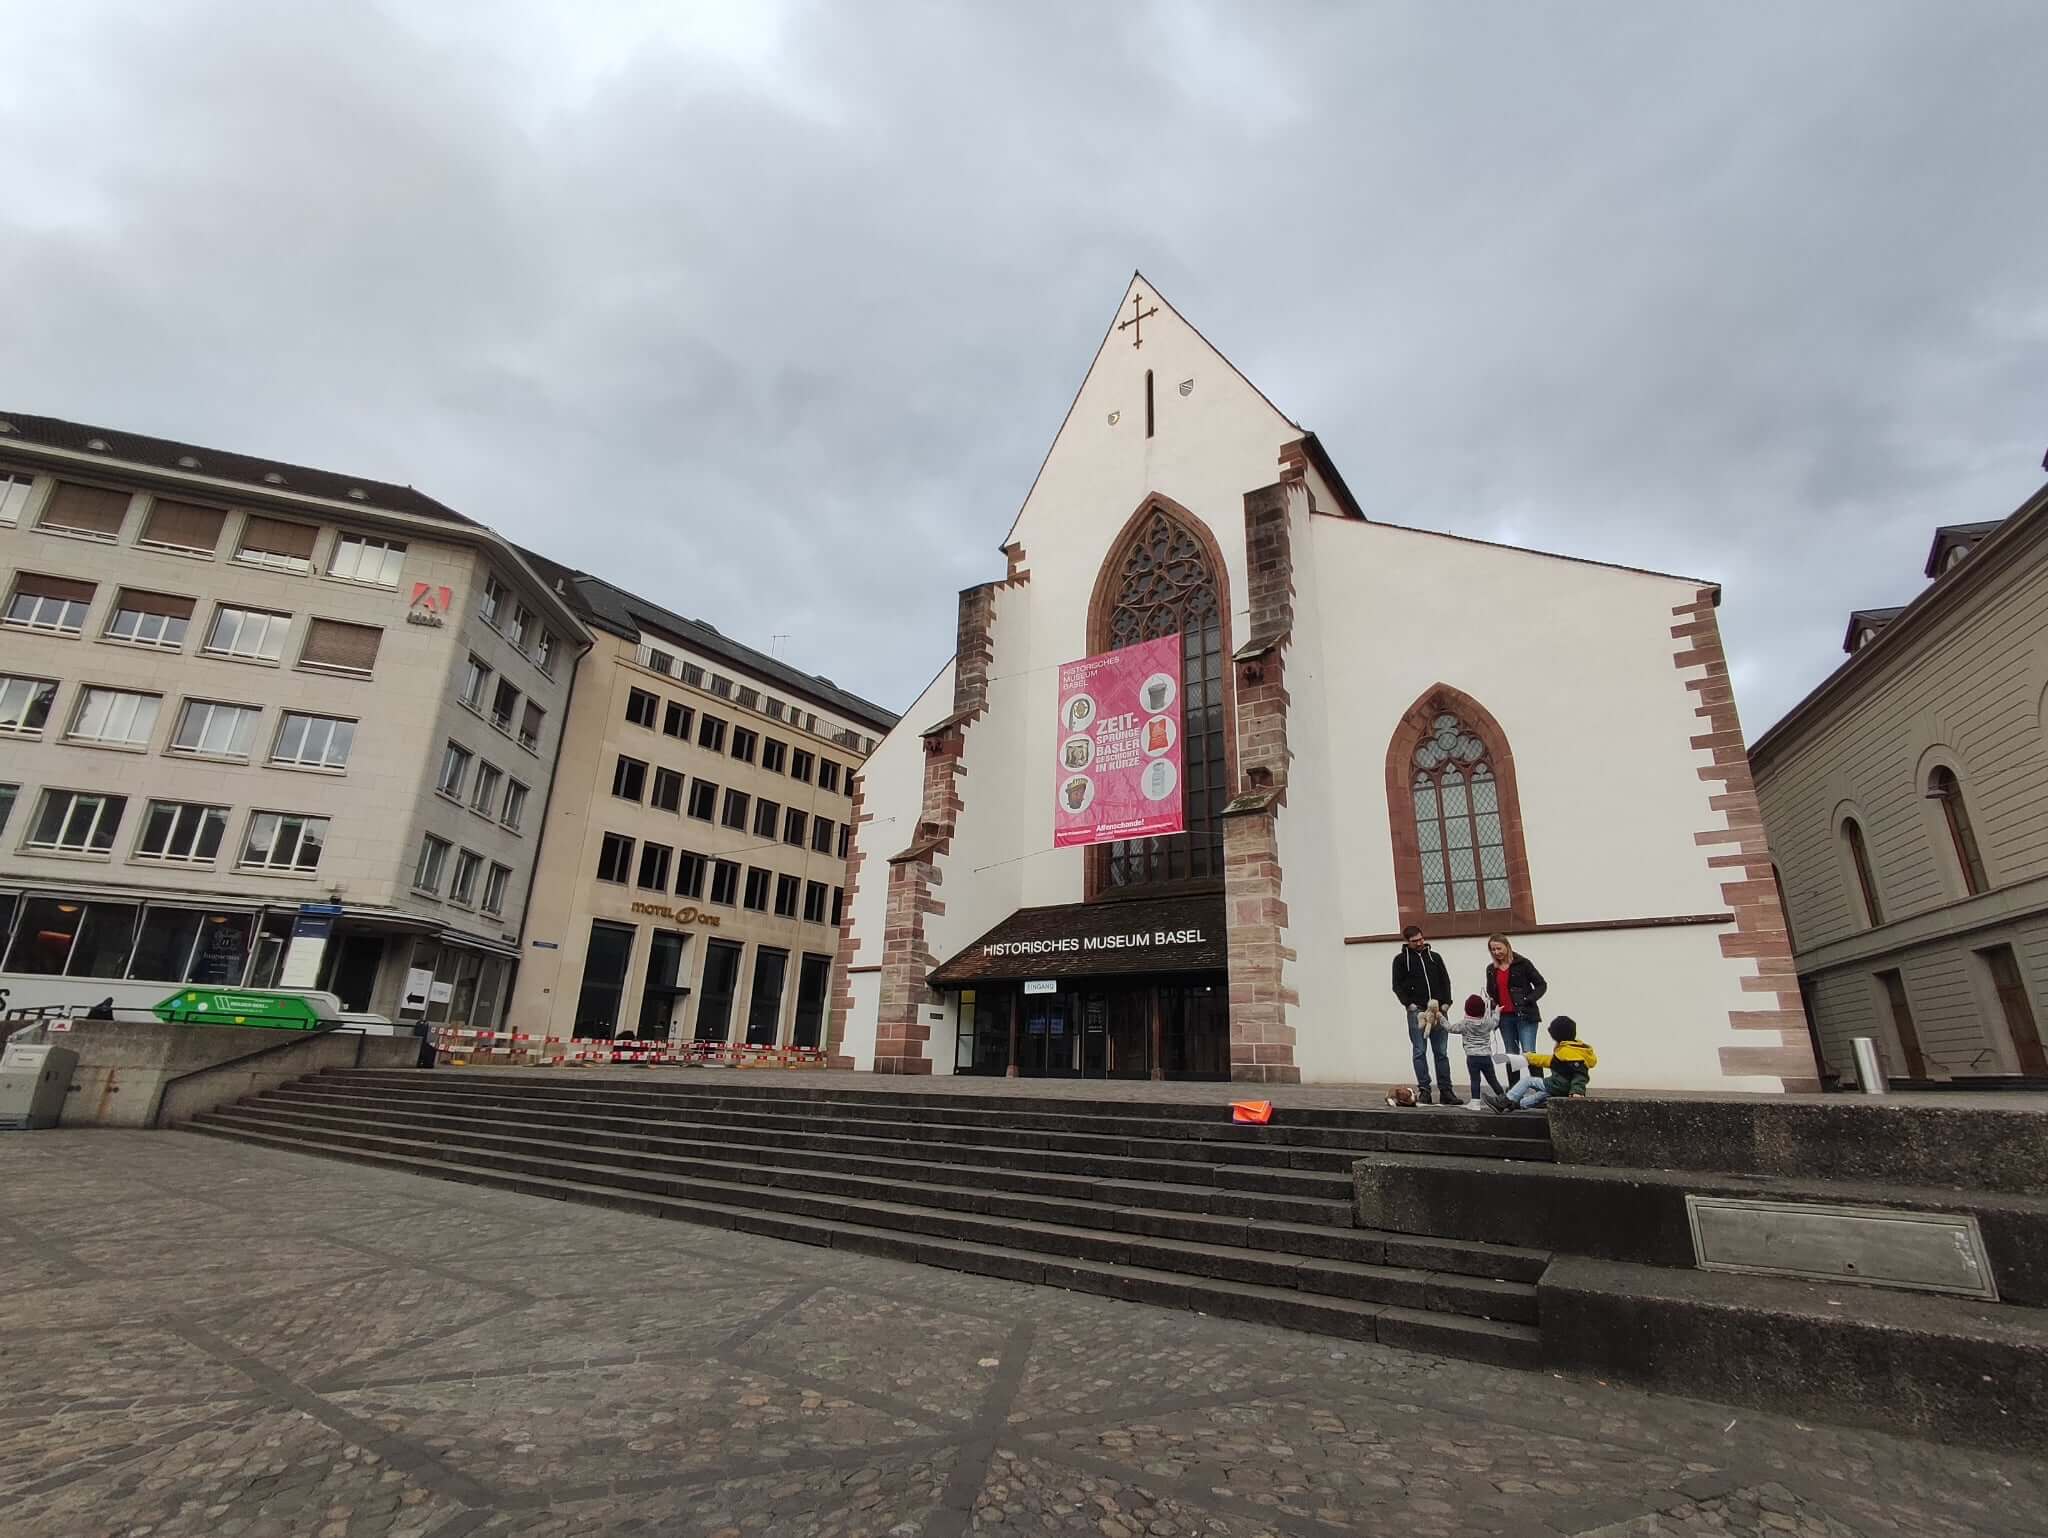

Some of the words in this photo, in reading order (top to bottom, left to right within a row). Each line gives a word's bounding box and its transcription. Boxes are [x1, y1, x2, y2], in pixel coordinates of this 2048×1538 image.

[406, 611, 444, 629] Adobe
[1063, 680, 1089, 689] BASEL
[1096, 712, 1139, 736] ZEIT-
[1095, 739, 1140, 757] BASLER
[983, 938, 1080, 957] HISTORISCHES
[1083, 933, 1150, 950] MUSEUM
[1155, 929, 1207, 945] BASEL
